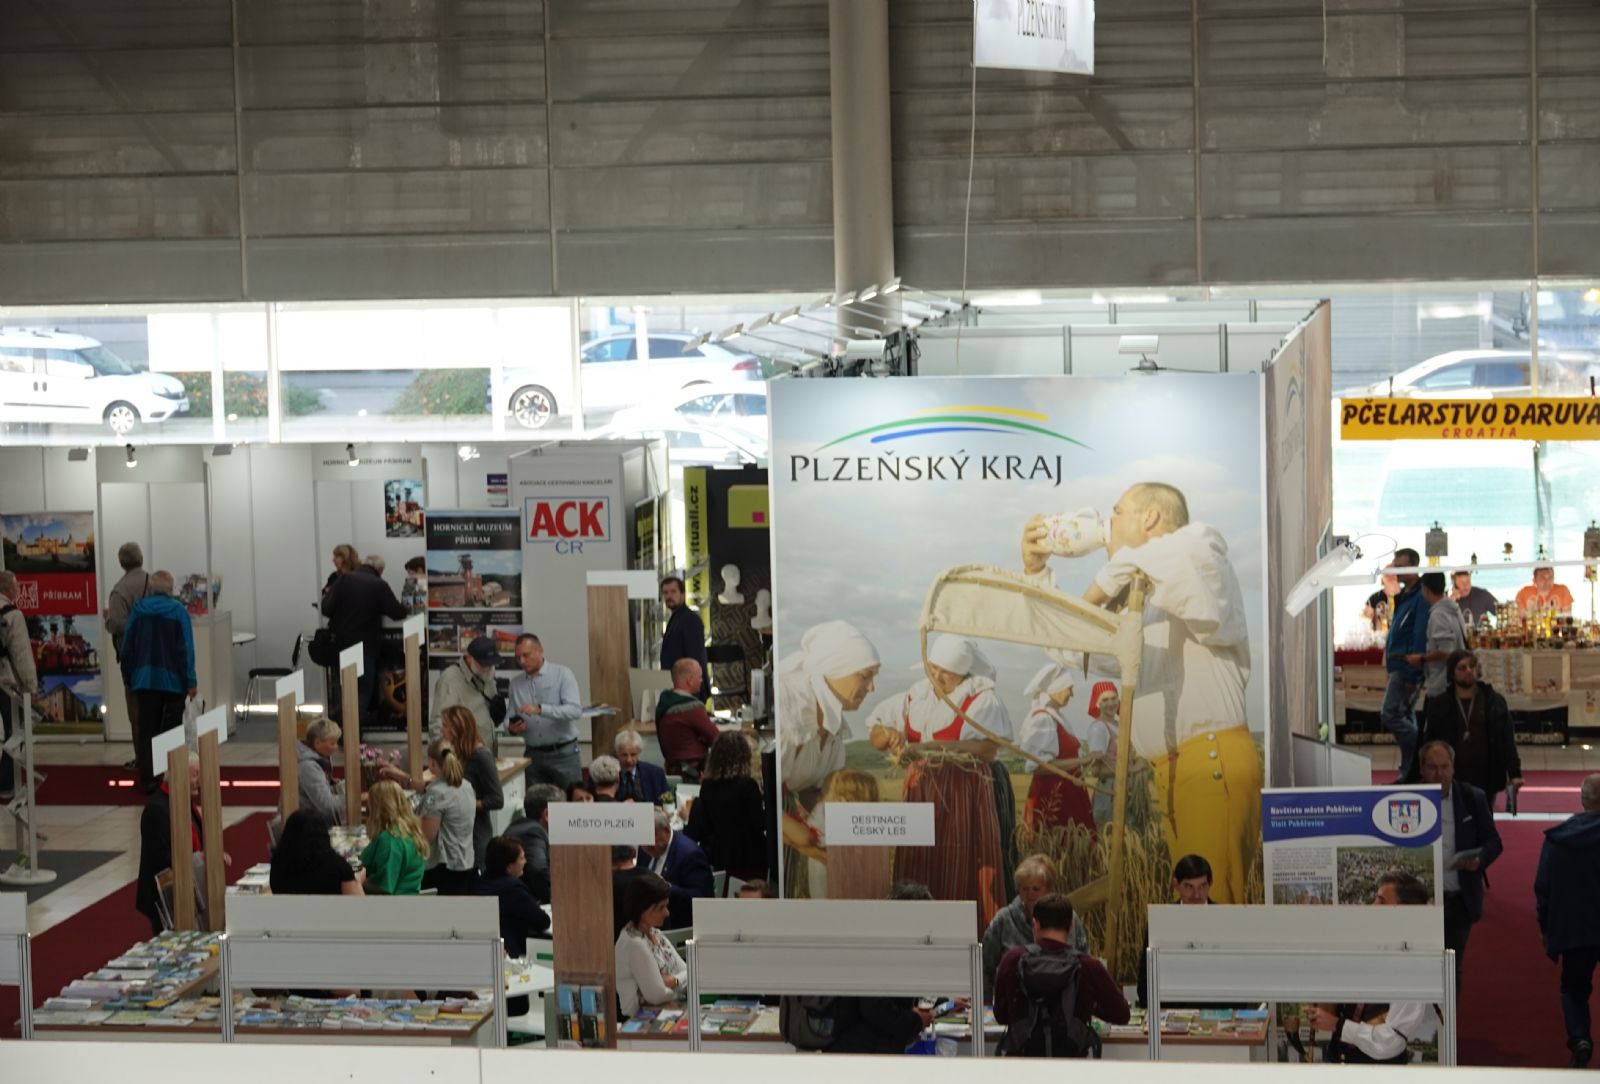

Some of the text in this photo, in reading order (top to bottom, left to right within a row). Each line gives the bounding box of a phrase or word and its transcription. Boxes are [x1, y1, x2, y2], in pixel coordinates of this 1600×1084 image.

[1343, 398, 1498, 426] PČELARSTVO
[1442, 427, 1517, 438] CROATIA
[790, 449, 1063, 487] PLZEŇSKÝ KRAJ
[530, 501, 604, 538] ACK
[433, 521, 512, 531] HORNICKÉ MUZEUM
[455, 534, 491, 544] PŘÍBRAM
[555, 538, 583, 554] ČR
[43, 590, 82, 600] PŘÍBRAM
[568, 816, 635, 828] MĚSTO PLZEŇ
[851, 815, 907, 825] DESTINACE
[852, 824, 907, 836] ČESKÝ LES
